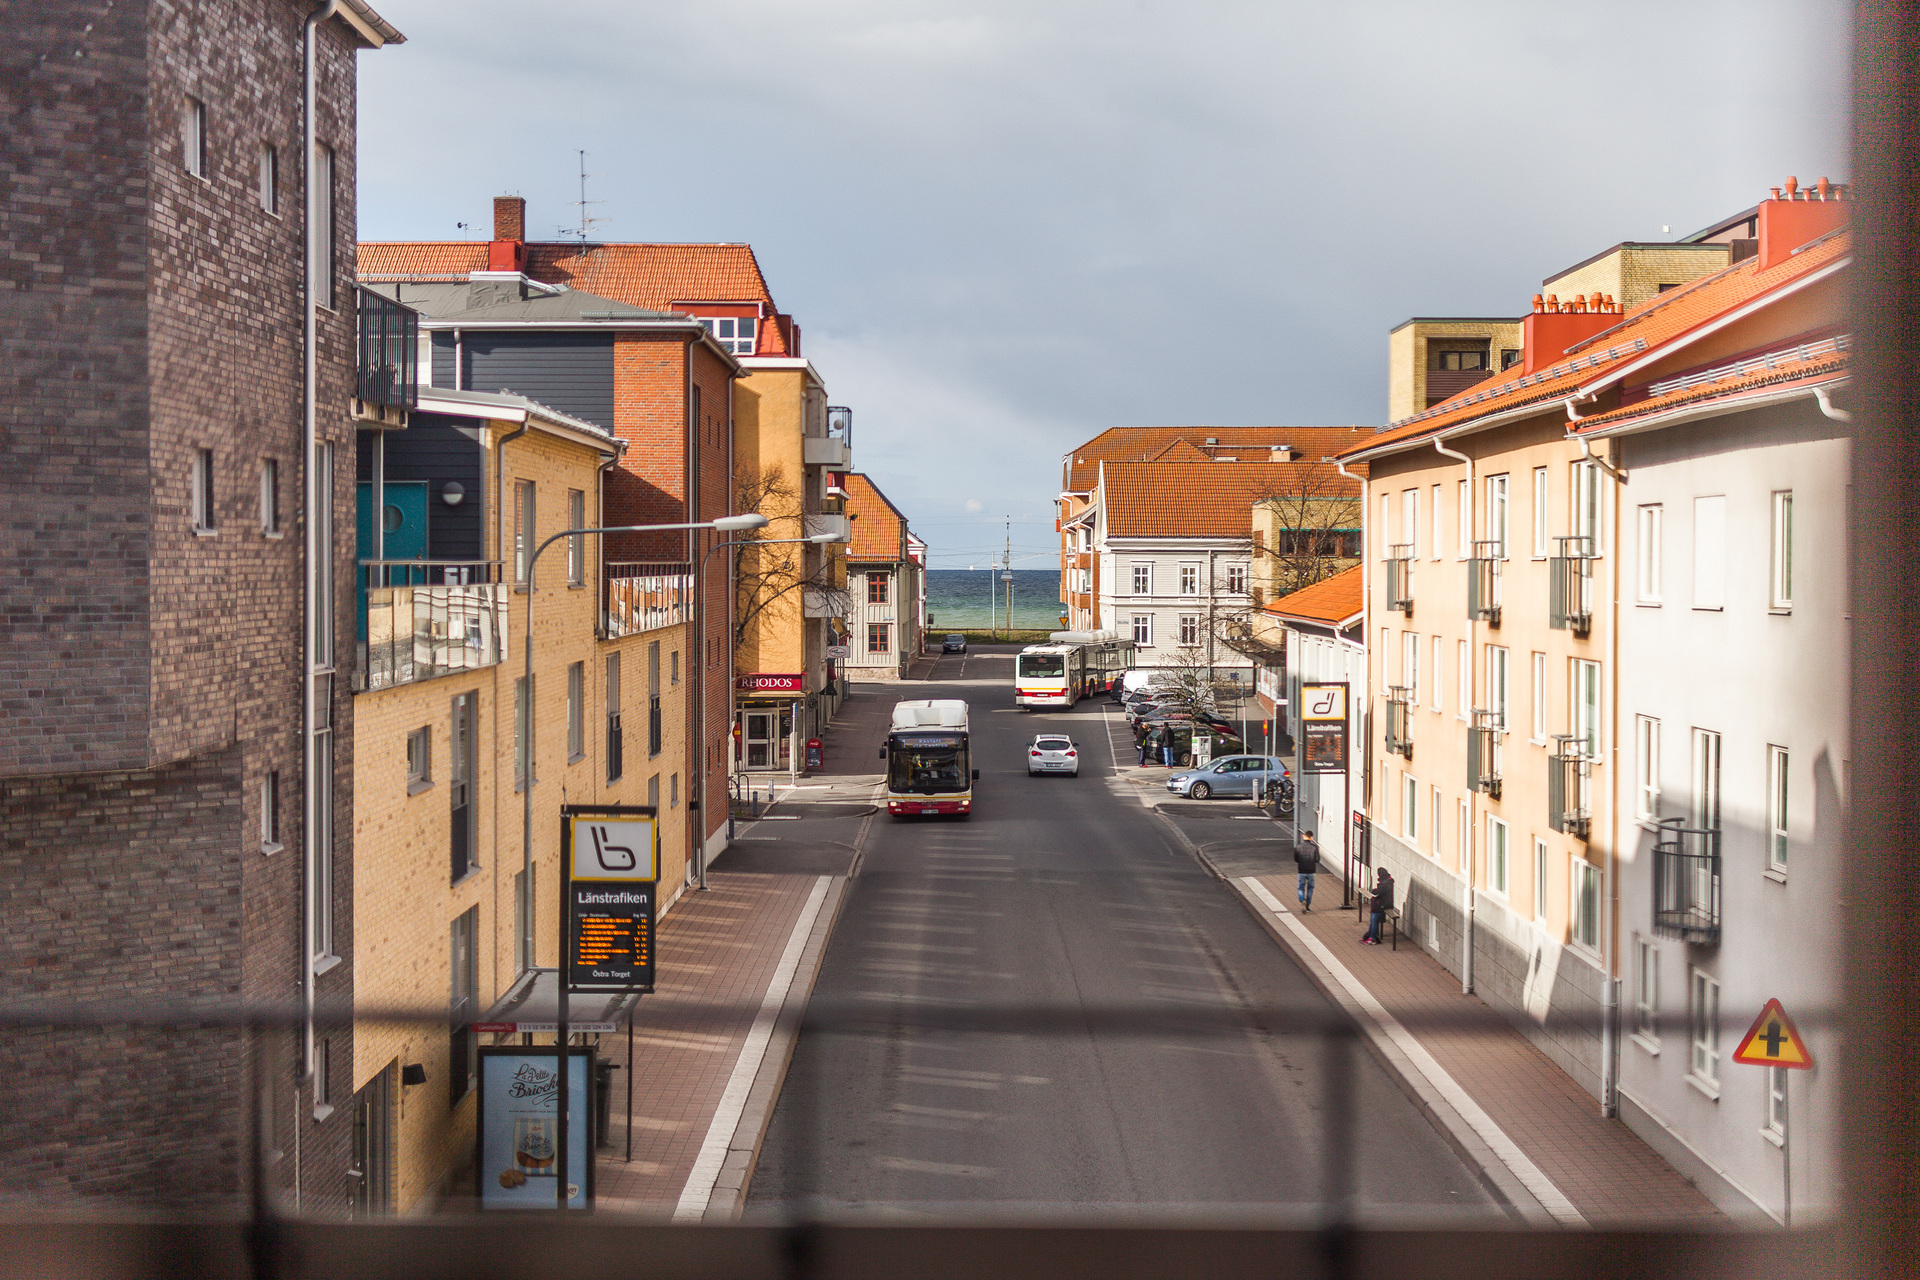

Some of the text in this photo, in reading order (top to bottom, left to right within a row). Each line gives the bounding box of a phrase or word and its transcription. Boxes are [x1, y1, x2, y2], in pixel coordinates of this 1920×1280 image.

[741, 677, 793, 688] RHODOS
[578, 892, 647, 904] Länstrafiken
[592, 969, 631, 979] Östra Torget
[513, 1063, 529, 1079] La
[508, 1073, 559, 1098] Brioch
